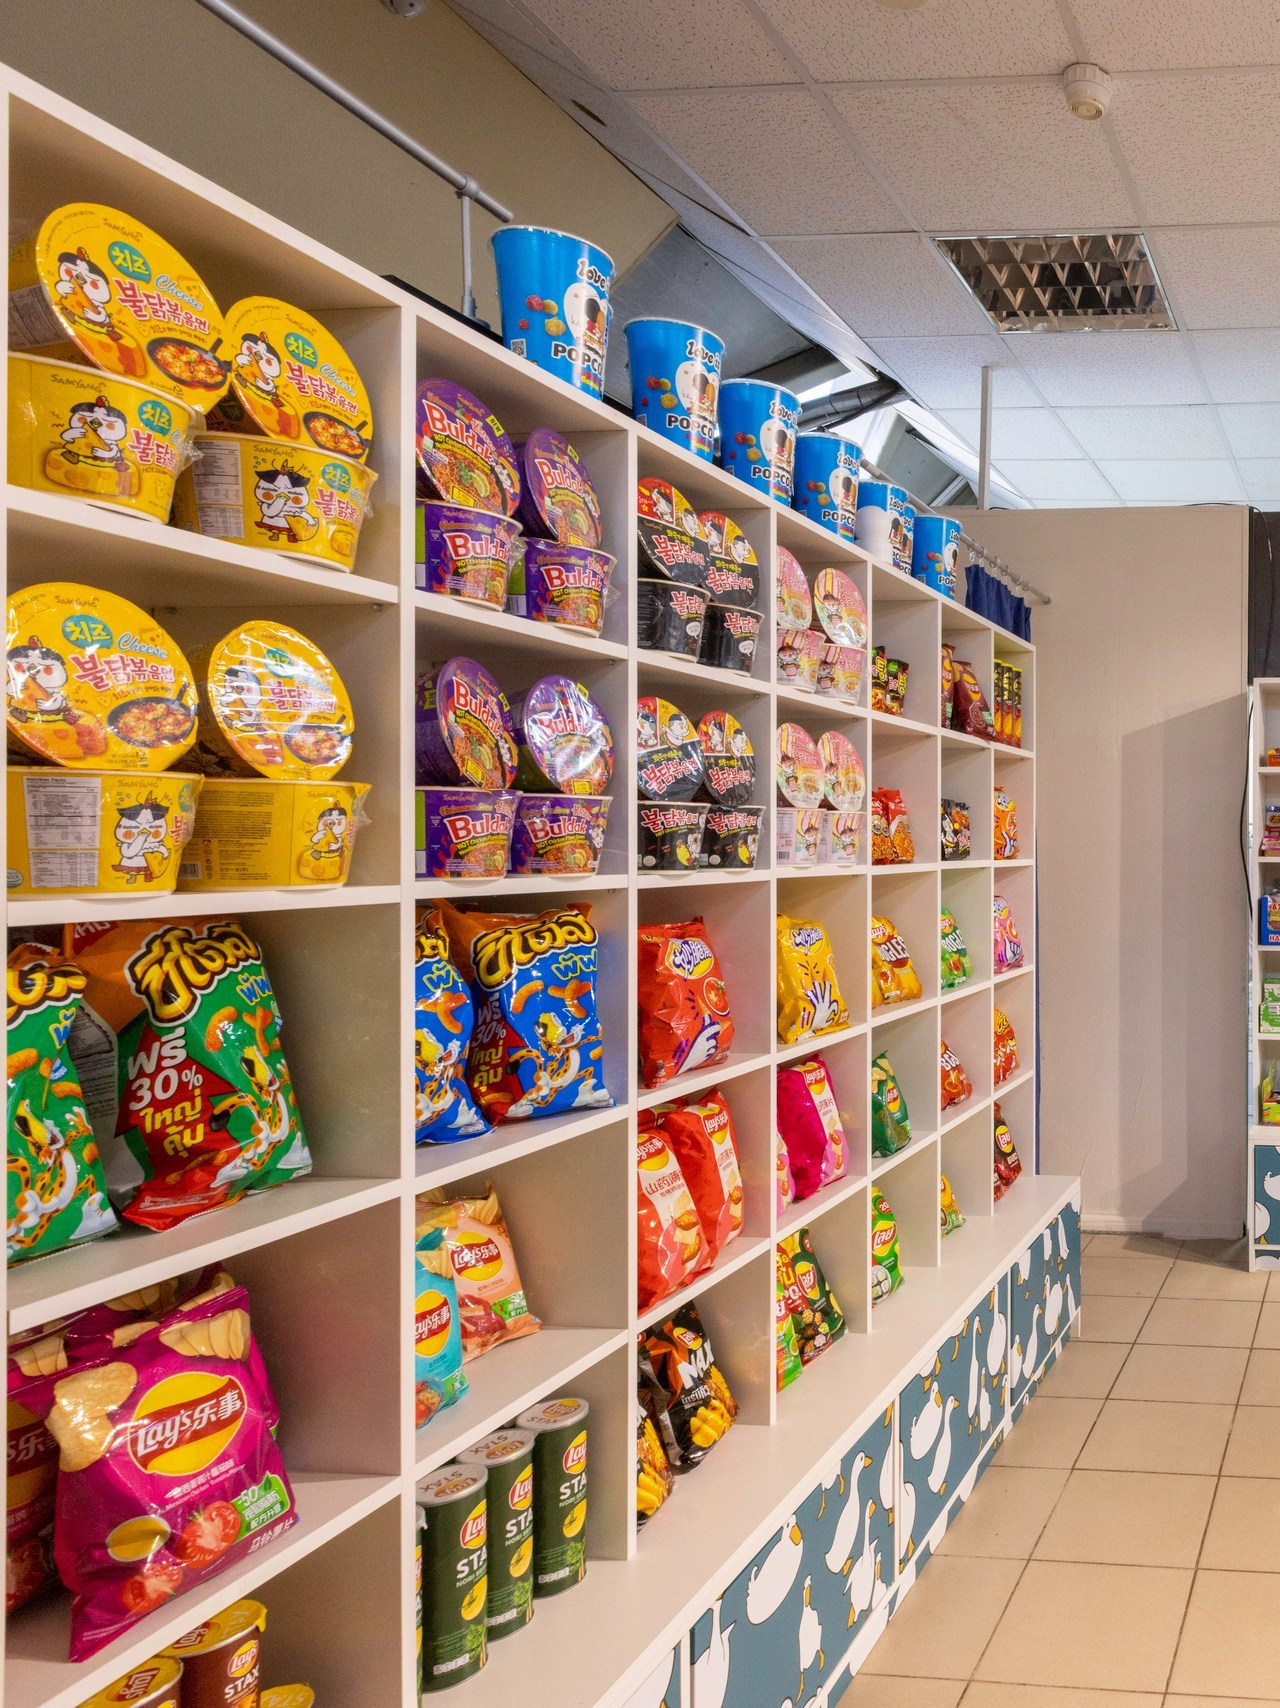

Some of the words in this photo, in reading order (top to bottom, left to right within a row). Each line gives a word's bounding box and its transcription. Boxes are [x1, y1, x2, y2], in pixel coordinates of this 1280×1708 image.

[113, 247, 148, 274] 치즈
[578, 259, 606, 288] love
[154, 274, 203, 311] Cheese
[116, 279, 209, 334] 불닭볶음면
[288, 339, 317, 364] 치즈
[687, 340, 713, 365] love
[51, 374, 107, 393] SAMYANG
[285, 362, 358, 416] 불닭볶음면
[319, 364, 356, 397] Cheese
[141, 406, 171, 432] 치즈
[422, 400, 493, 463] Buldak
[489, 418, 501, 433] NEW
[325, 469, 350, 491] 치즈
[535, 459, 584, 495] Buldak
[444, 533, 509, 561] Buldak
[541, 566, 602, 591] Buldak
[552, 589, 563, 598] HOT
[67, 618, 111, 643] 치즈
[116, 633, 168, 660] Cheese
[67, 654, 175, 691] 불닭볶음면
[453, 678, 500, 737] Buldak
[537, 713, 589, 739] Buldak
[444, 814, 511, 842] Buldak
[525, 816, 587, 842] Buldak
[641, 808, 698, 832] 불닭볶음면
[707, 812, 757, 835] 불닭볶음면
[457, 841, 469, 850] HOT
[472, 1023, 506, 1048] 30%
[127, 1027, 188, 1080] ฟรี
[472, 1040, 503, 1067] ใหญ่
[129, 1065, 203, 1111] 30%
[474, 1064, 503, 1092] คุ้ม
[139, 1088, 202, 1134] ใหญ่
[163, 1118, 205, 1158] คุ้ม
[873, 1223, 897, 1250] เลย์
[677, 1339, 714, 1389] MAX
[526, 1415, 561, 1426] STAX
[418, 1470, 464, 1493] STAX
[455, 1574, 475, 1588] NORI
[224, 1664, 259, 1698] STAX
